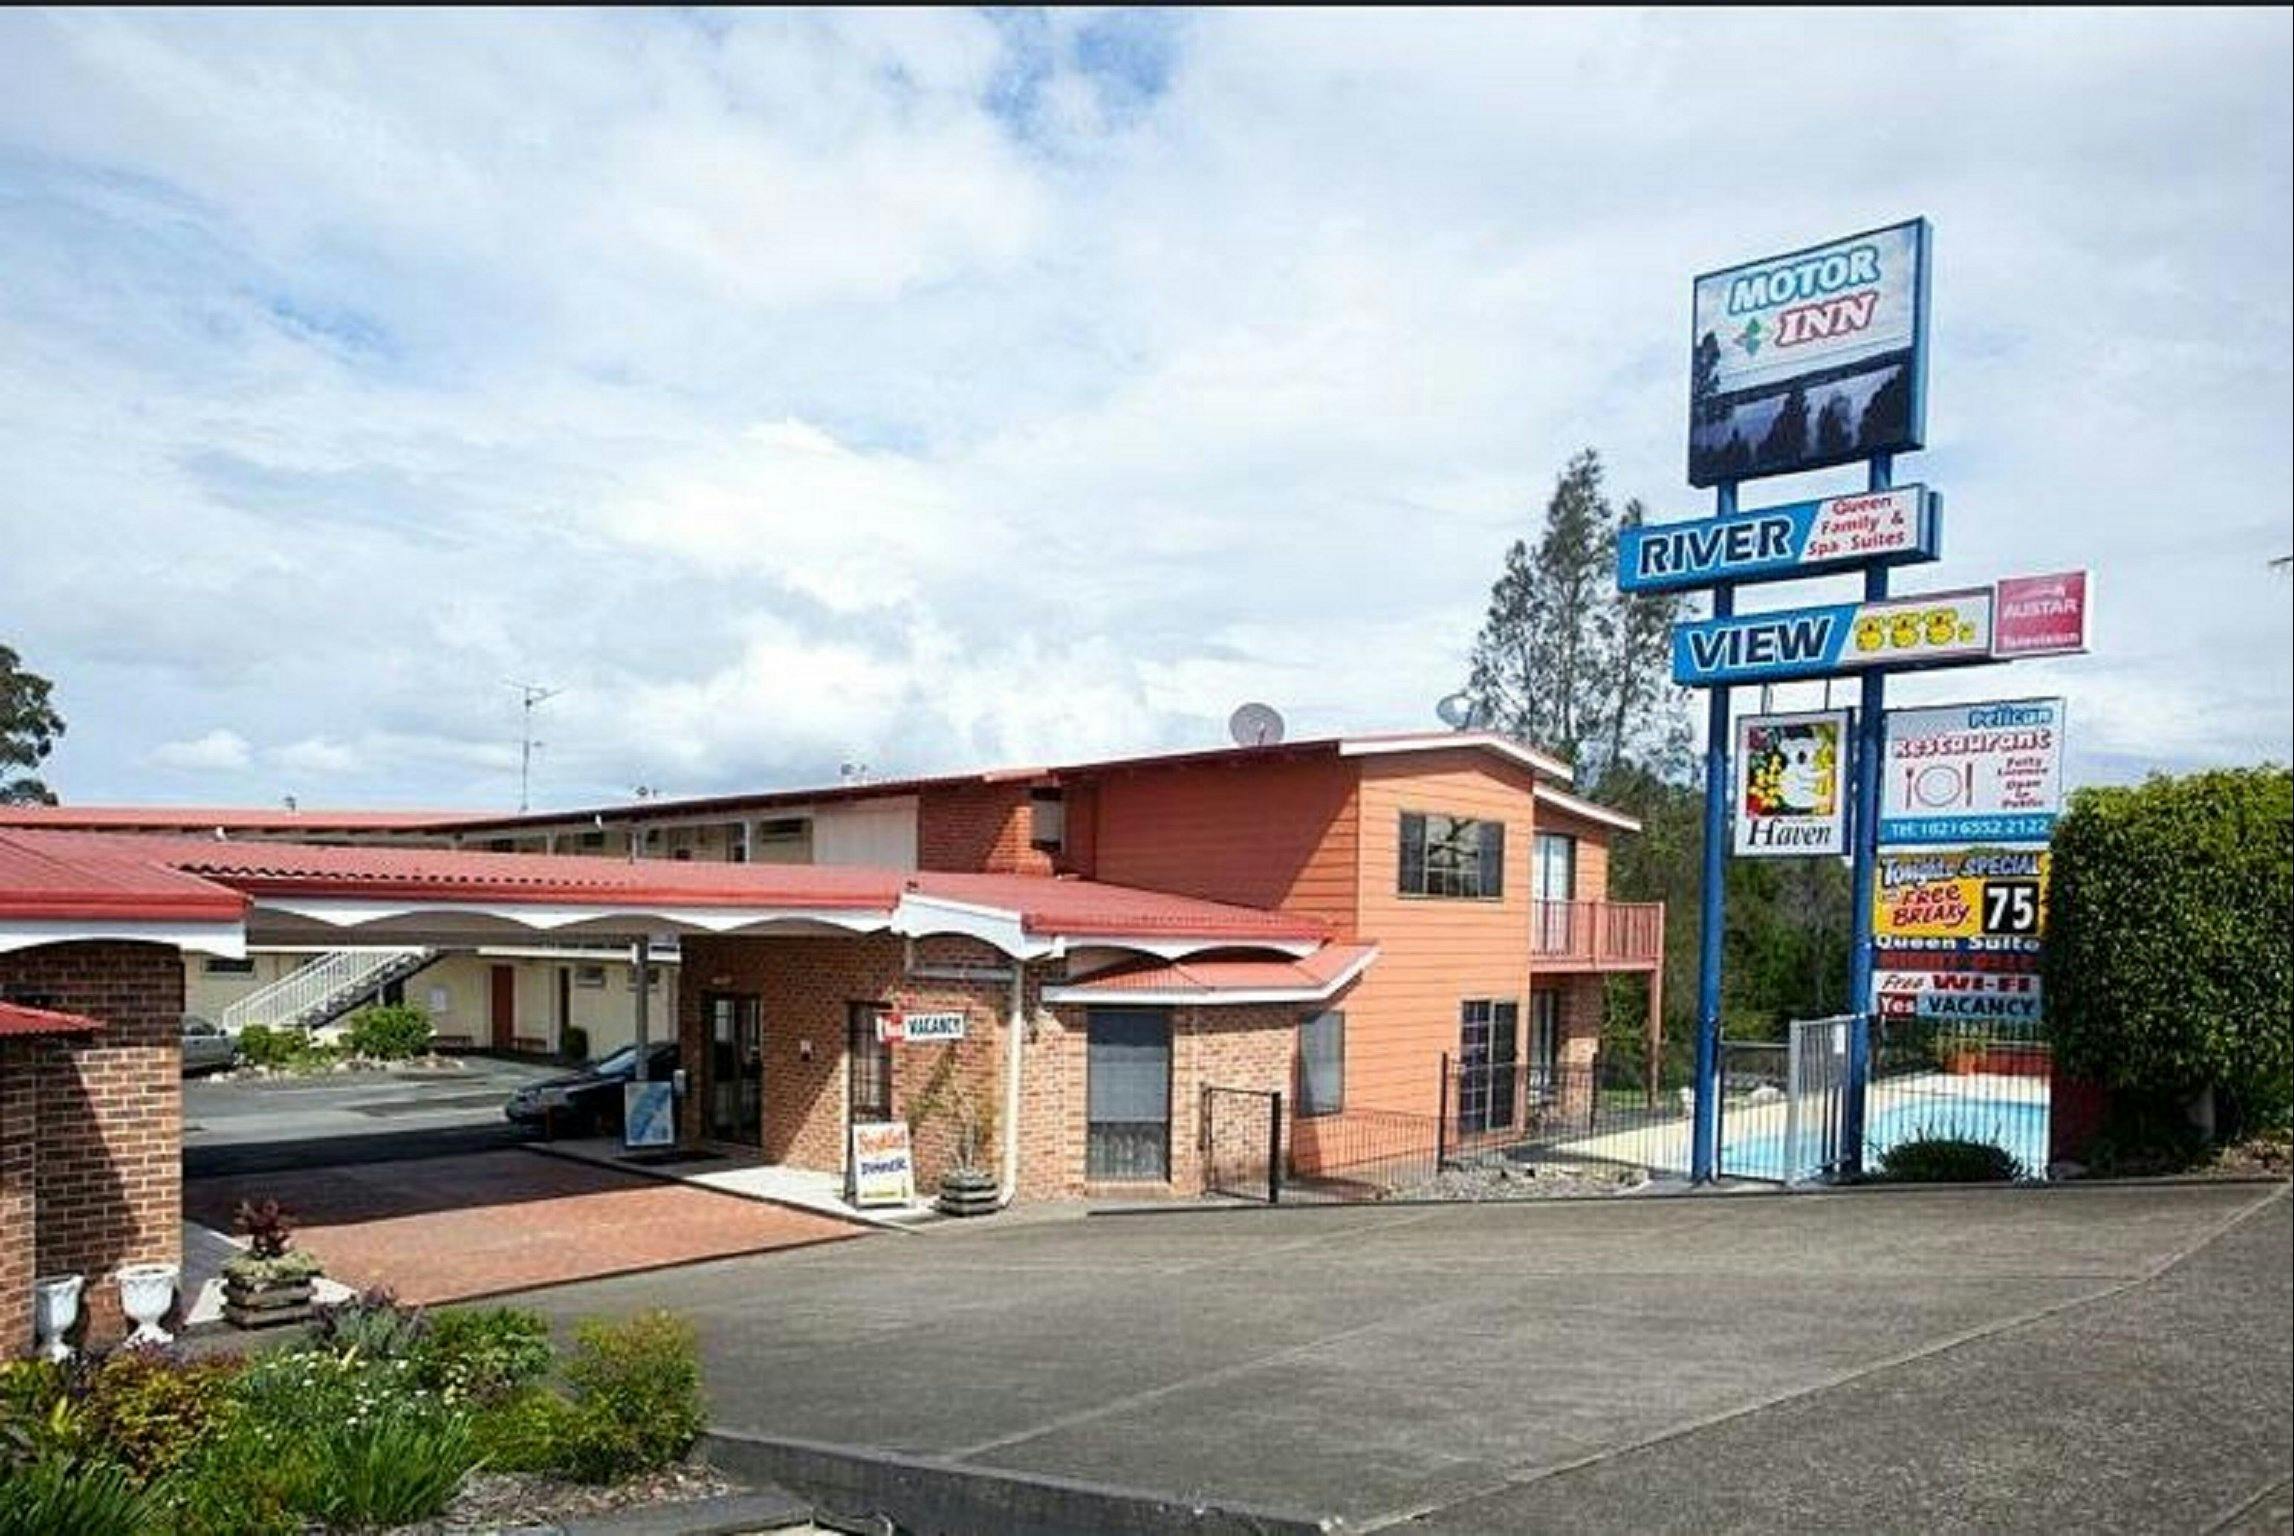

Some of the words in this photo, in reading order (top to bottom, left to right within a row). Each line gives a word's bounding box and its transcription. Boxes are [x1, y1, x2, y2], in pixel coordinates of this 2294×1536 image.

[1728, 245, 1880, 316] MOTOR
[1775, 290, 1879, 346] INN
[1832, 497, 1891, 515] Queen
[1821, 516, 1879, 535] Family
[1891, 511, 1904, 525] &
[1637, 515, 1793, 578] RIVER
[1807, 541, 1839, 556] Spa
[1850, 531, 1904, 550] Suites
[2003, 598, 2078, 618] AUSTAR
[1688, 616, 1833, 671] VIEW
[1748, 817, 1831, 846] Haven
[1987, 886, 2035, 930] 75
[1876, 934, 1956, 949] Queen
[1968, 934, 2040, 950] Suite
[1881, 997, 1914, 1013] Yes
[1927, 997, 2034, 1016] VACANCY
[908, 1016, 962, 1035] VACANCY
